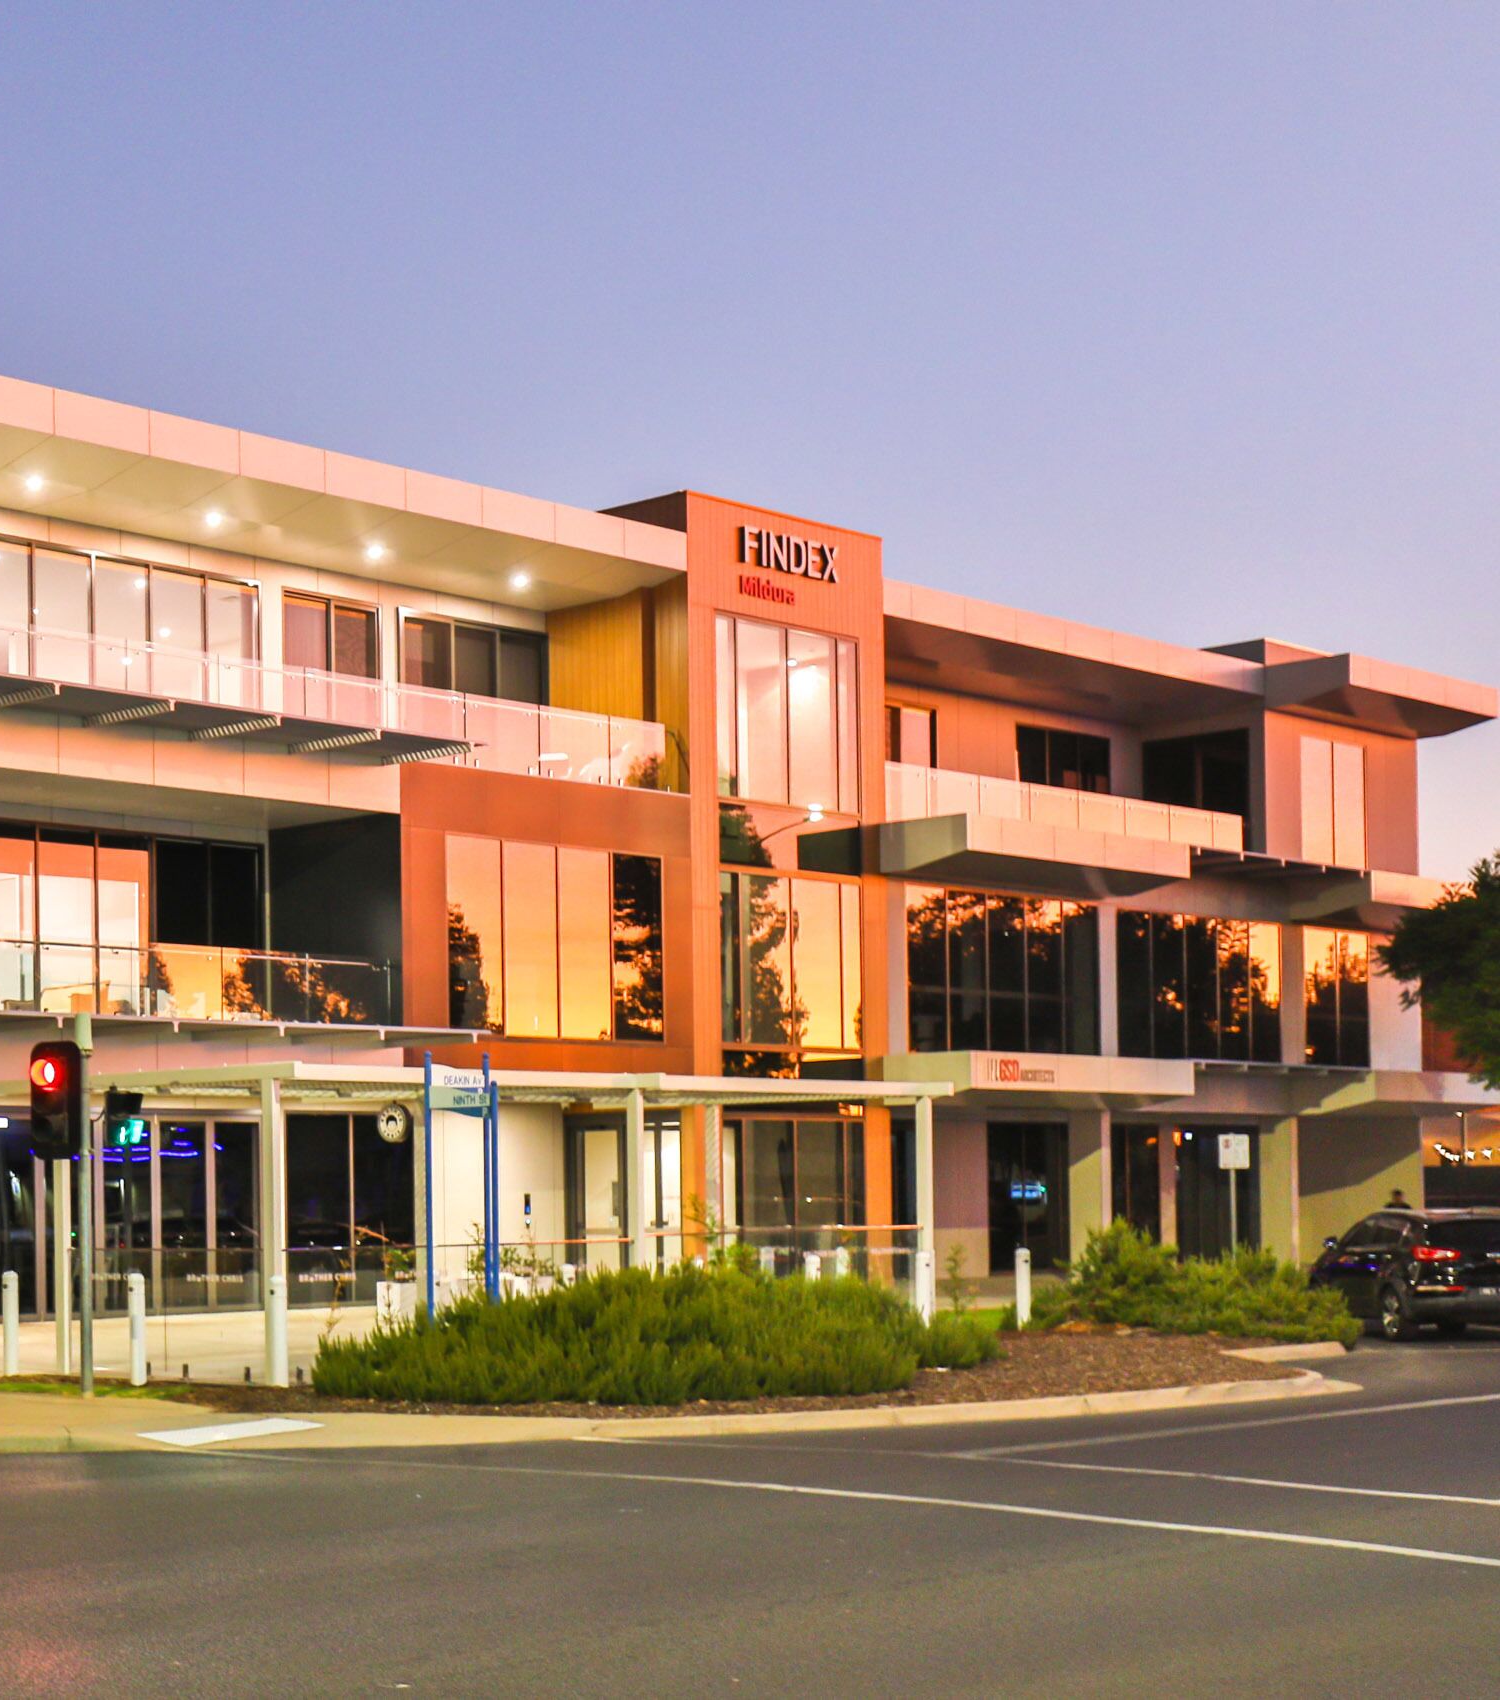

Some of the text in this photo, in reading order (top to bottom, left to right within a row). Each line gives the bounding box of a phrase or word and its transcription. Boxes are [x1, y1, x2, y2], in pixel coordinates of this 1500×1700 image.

[739, 525, 838, 583] FINDEX
[739, 575, 795, 605] Mildura
[443, 1075, 470, 1086] DEAKIN
[453, 1095, 476, 1106] NINTH
